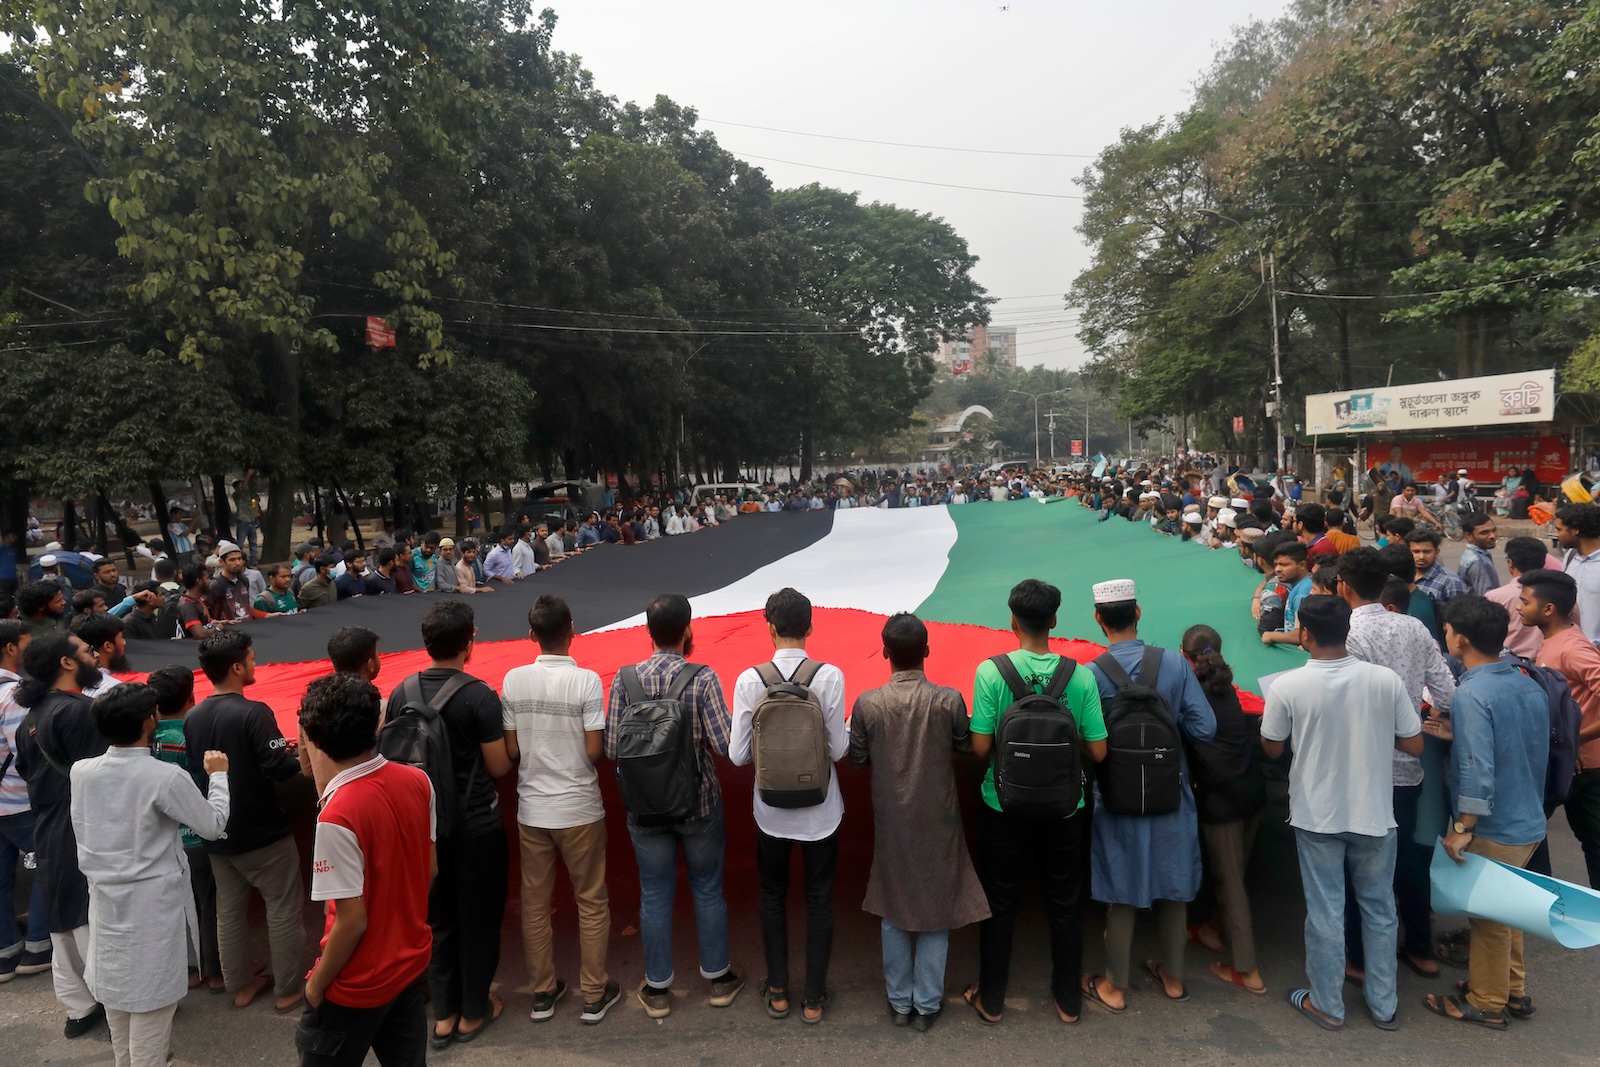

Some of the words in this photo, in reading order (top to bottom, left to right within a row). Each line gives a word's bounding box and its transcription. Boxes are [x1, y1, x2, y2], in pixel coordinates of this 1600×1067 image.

[1399, 394, 1448, 409] মুহূর্তগুলো
[1451, 390, 1481, 404] জমুক
[1500, 380, 1543, 408] রুচি
[1409, 408, 1440, 418] দারুণ
[1442, 406, 1469, 417] স্বাদে
[269, 737, 287, 750] QNB
